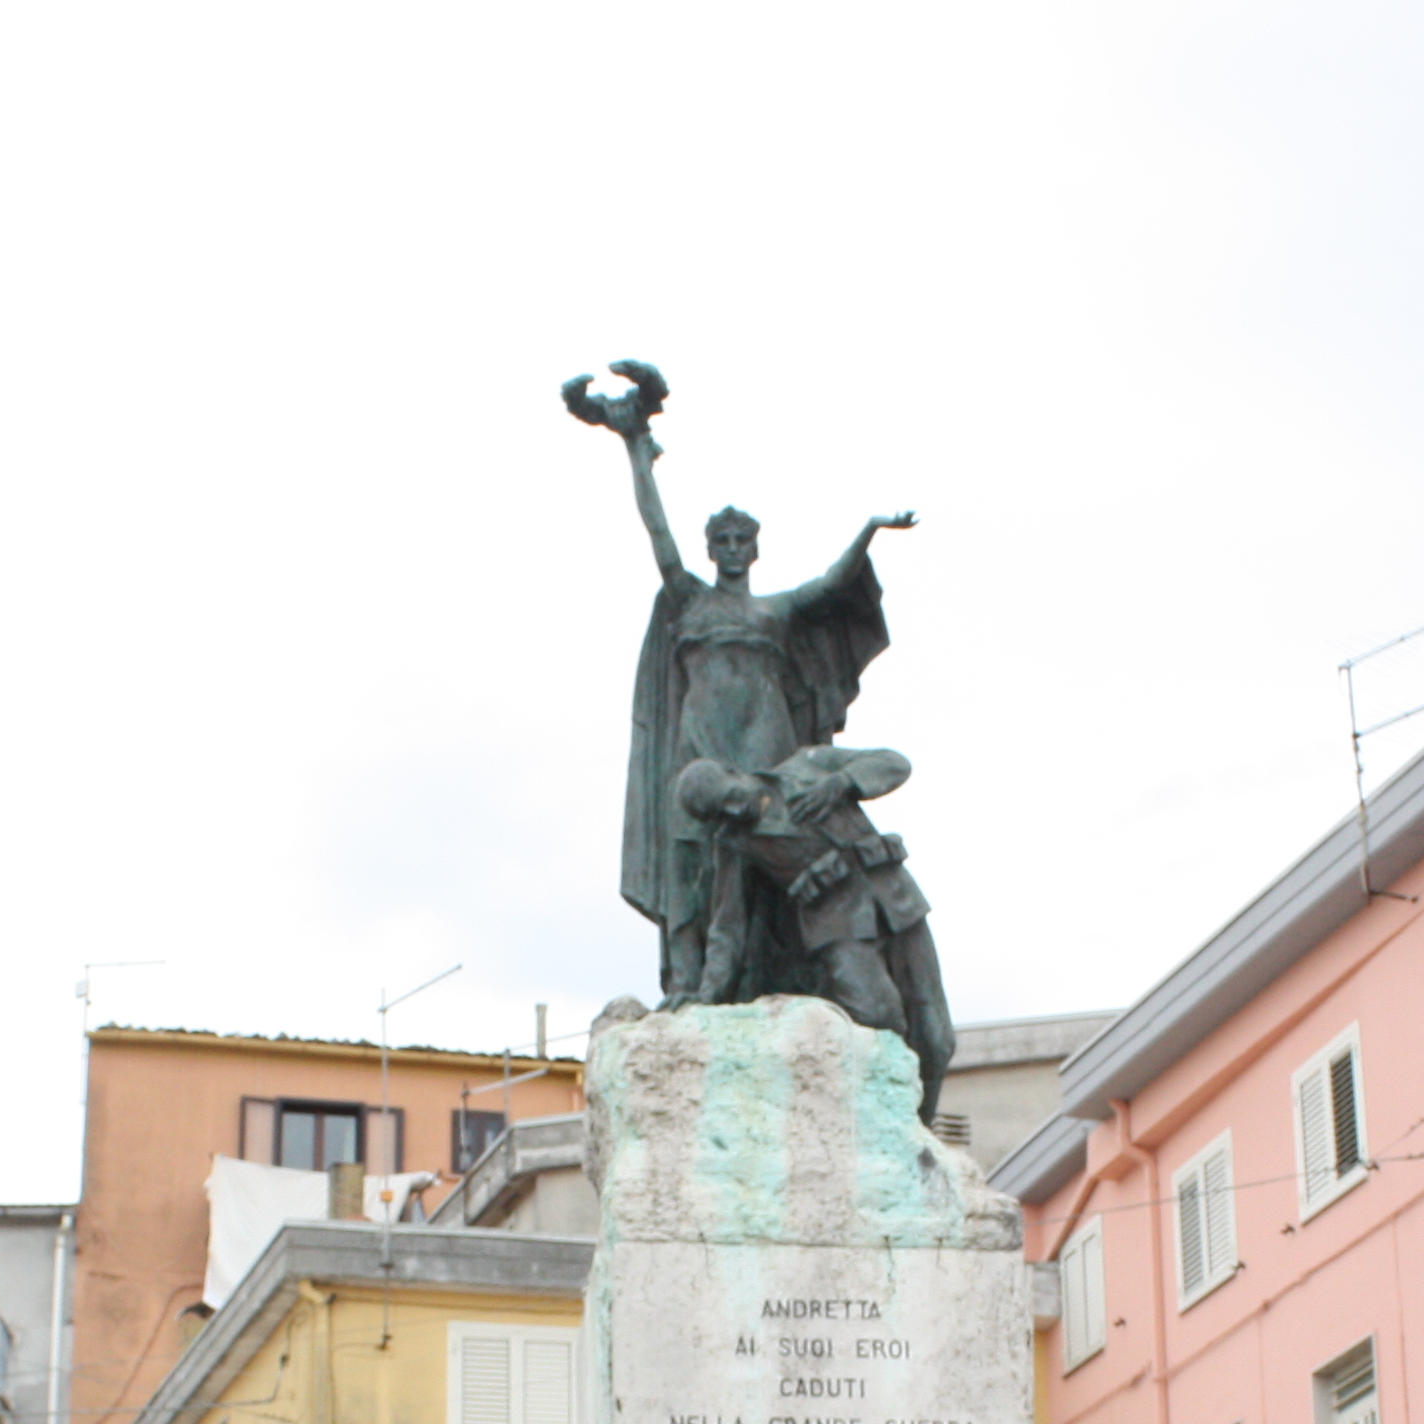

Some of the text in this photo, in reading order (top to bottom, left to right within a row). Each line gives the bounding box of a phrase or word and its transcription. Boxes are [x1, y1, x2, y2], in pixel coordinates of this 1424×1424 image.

[761, 1298, 883, 1321] ANDRETTA
[734, 1337, 911, 1360] AI SUOI EROI
[779, 1377, 866, 1399] CADUTI
